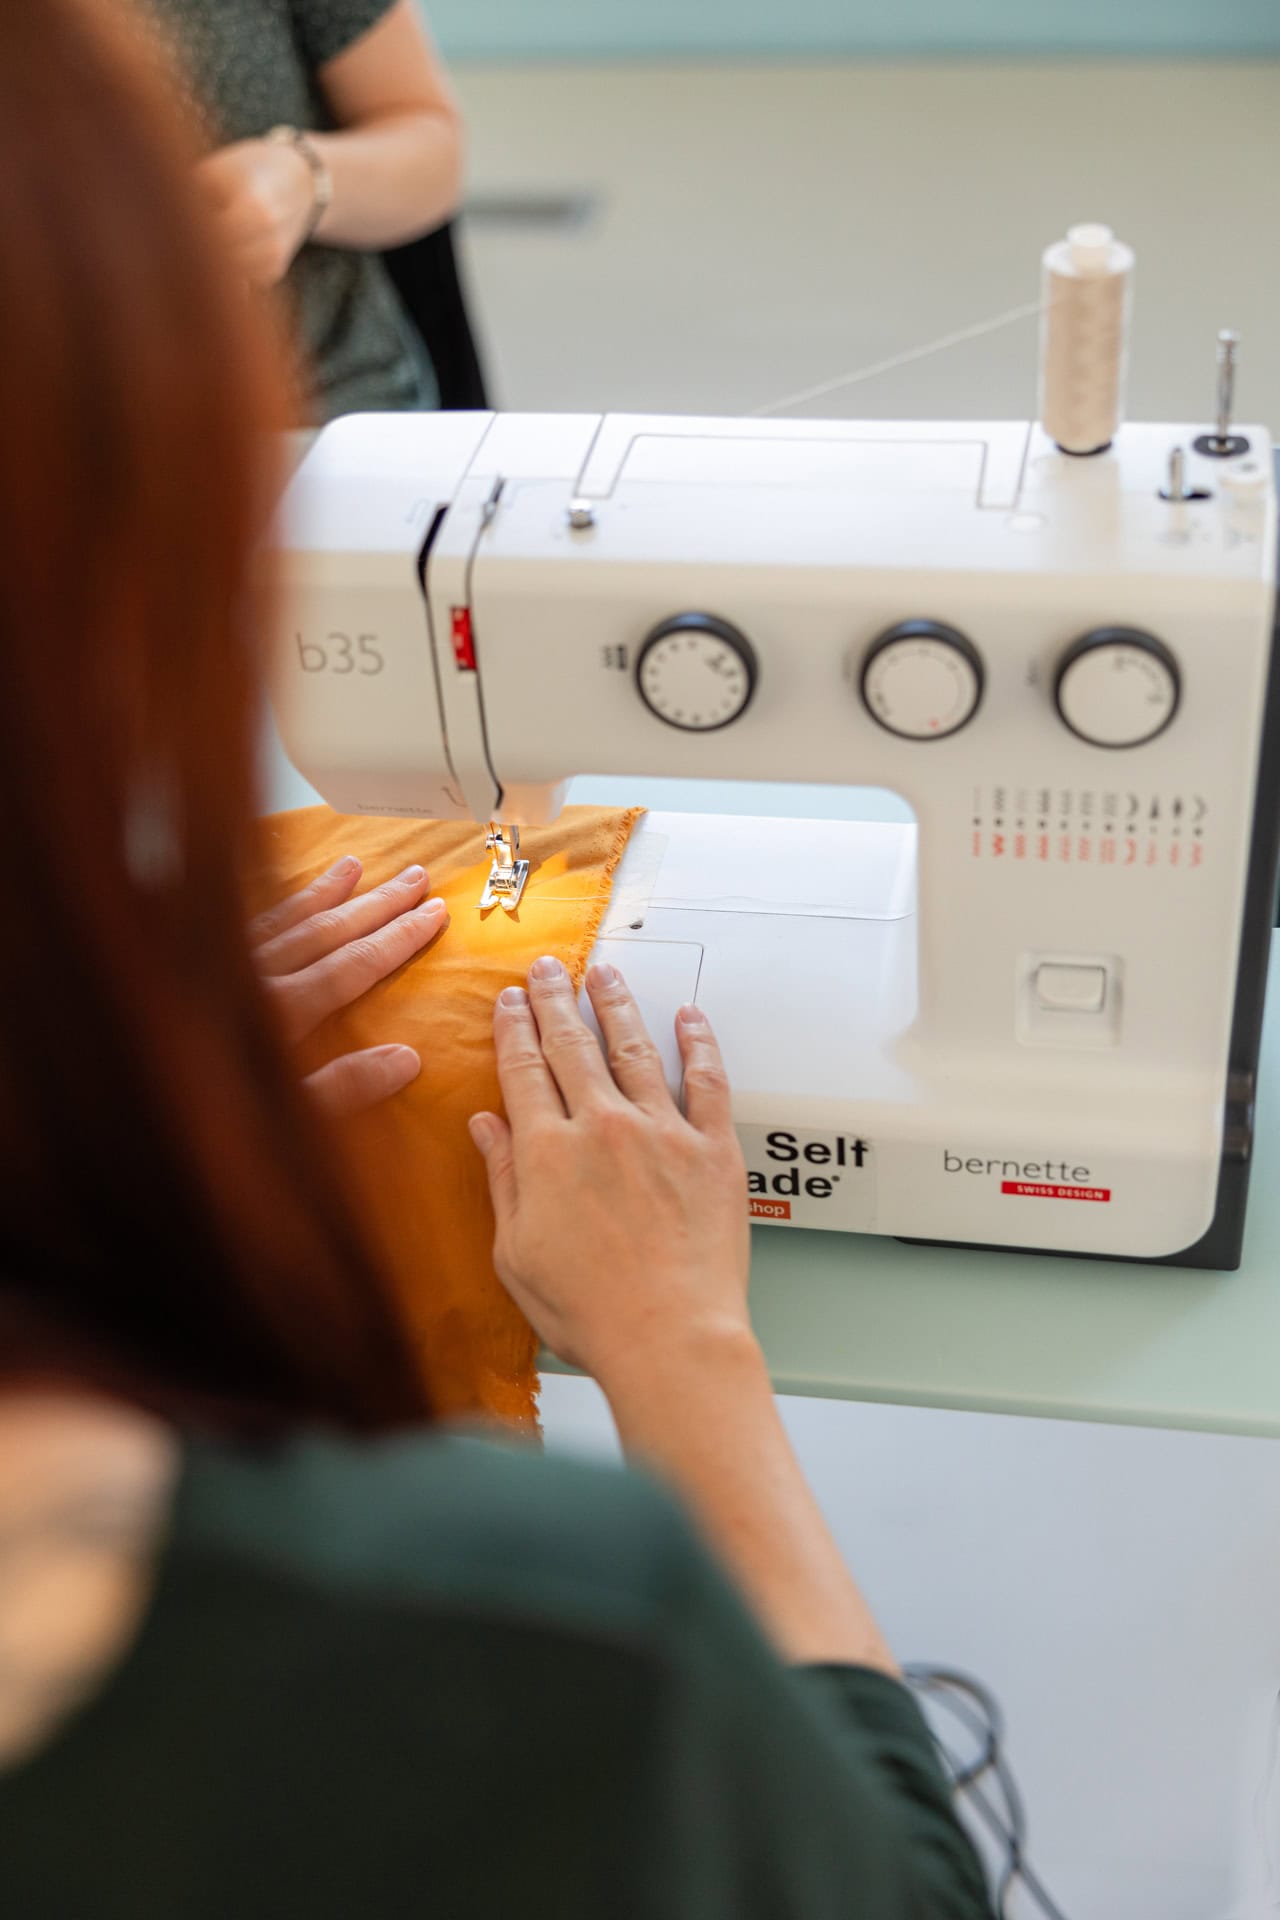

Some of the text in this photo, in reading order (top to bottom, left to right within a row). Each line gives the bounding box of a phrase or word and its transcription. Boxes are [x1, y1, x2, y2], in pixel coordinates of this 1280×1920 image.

[295, 631, 385, 676] b35
[943, 1149, 1091, 1183] bernette
[747, 1167, 833, 1198] ade
[1016, 1184, 1104, 1200] SWISS DESIGN
